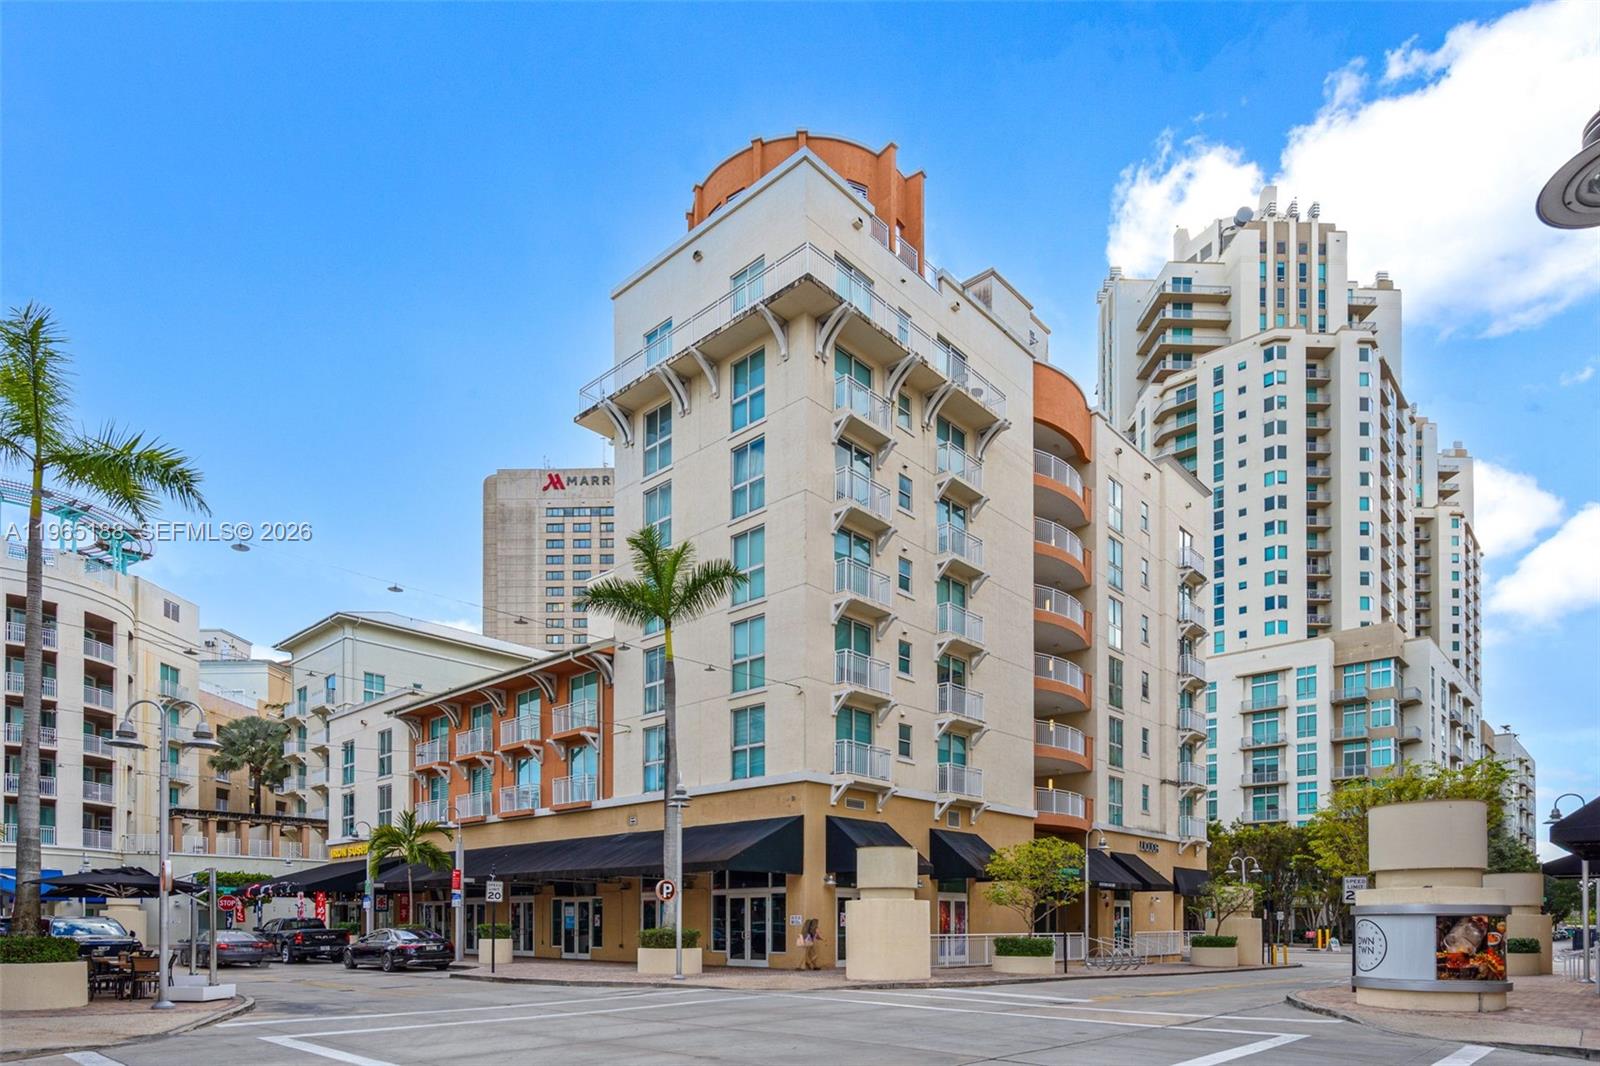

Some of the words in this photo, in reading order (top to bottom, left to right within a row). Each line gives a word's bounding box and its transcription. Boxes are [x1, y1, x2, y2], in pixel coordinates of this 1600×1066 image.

[487, 891, 502, 900] 20
[1345, 890, 1355, 900] 2
[219, 899, 236, 907] STOP
